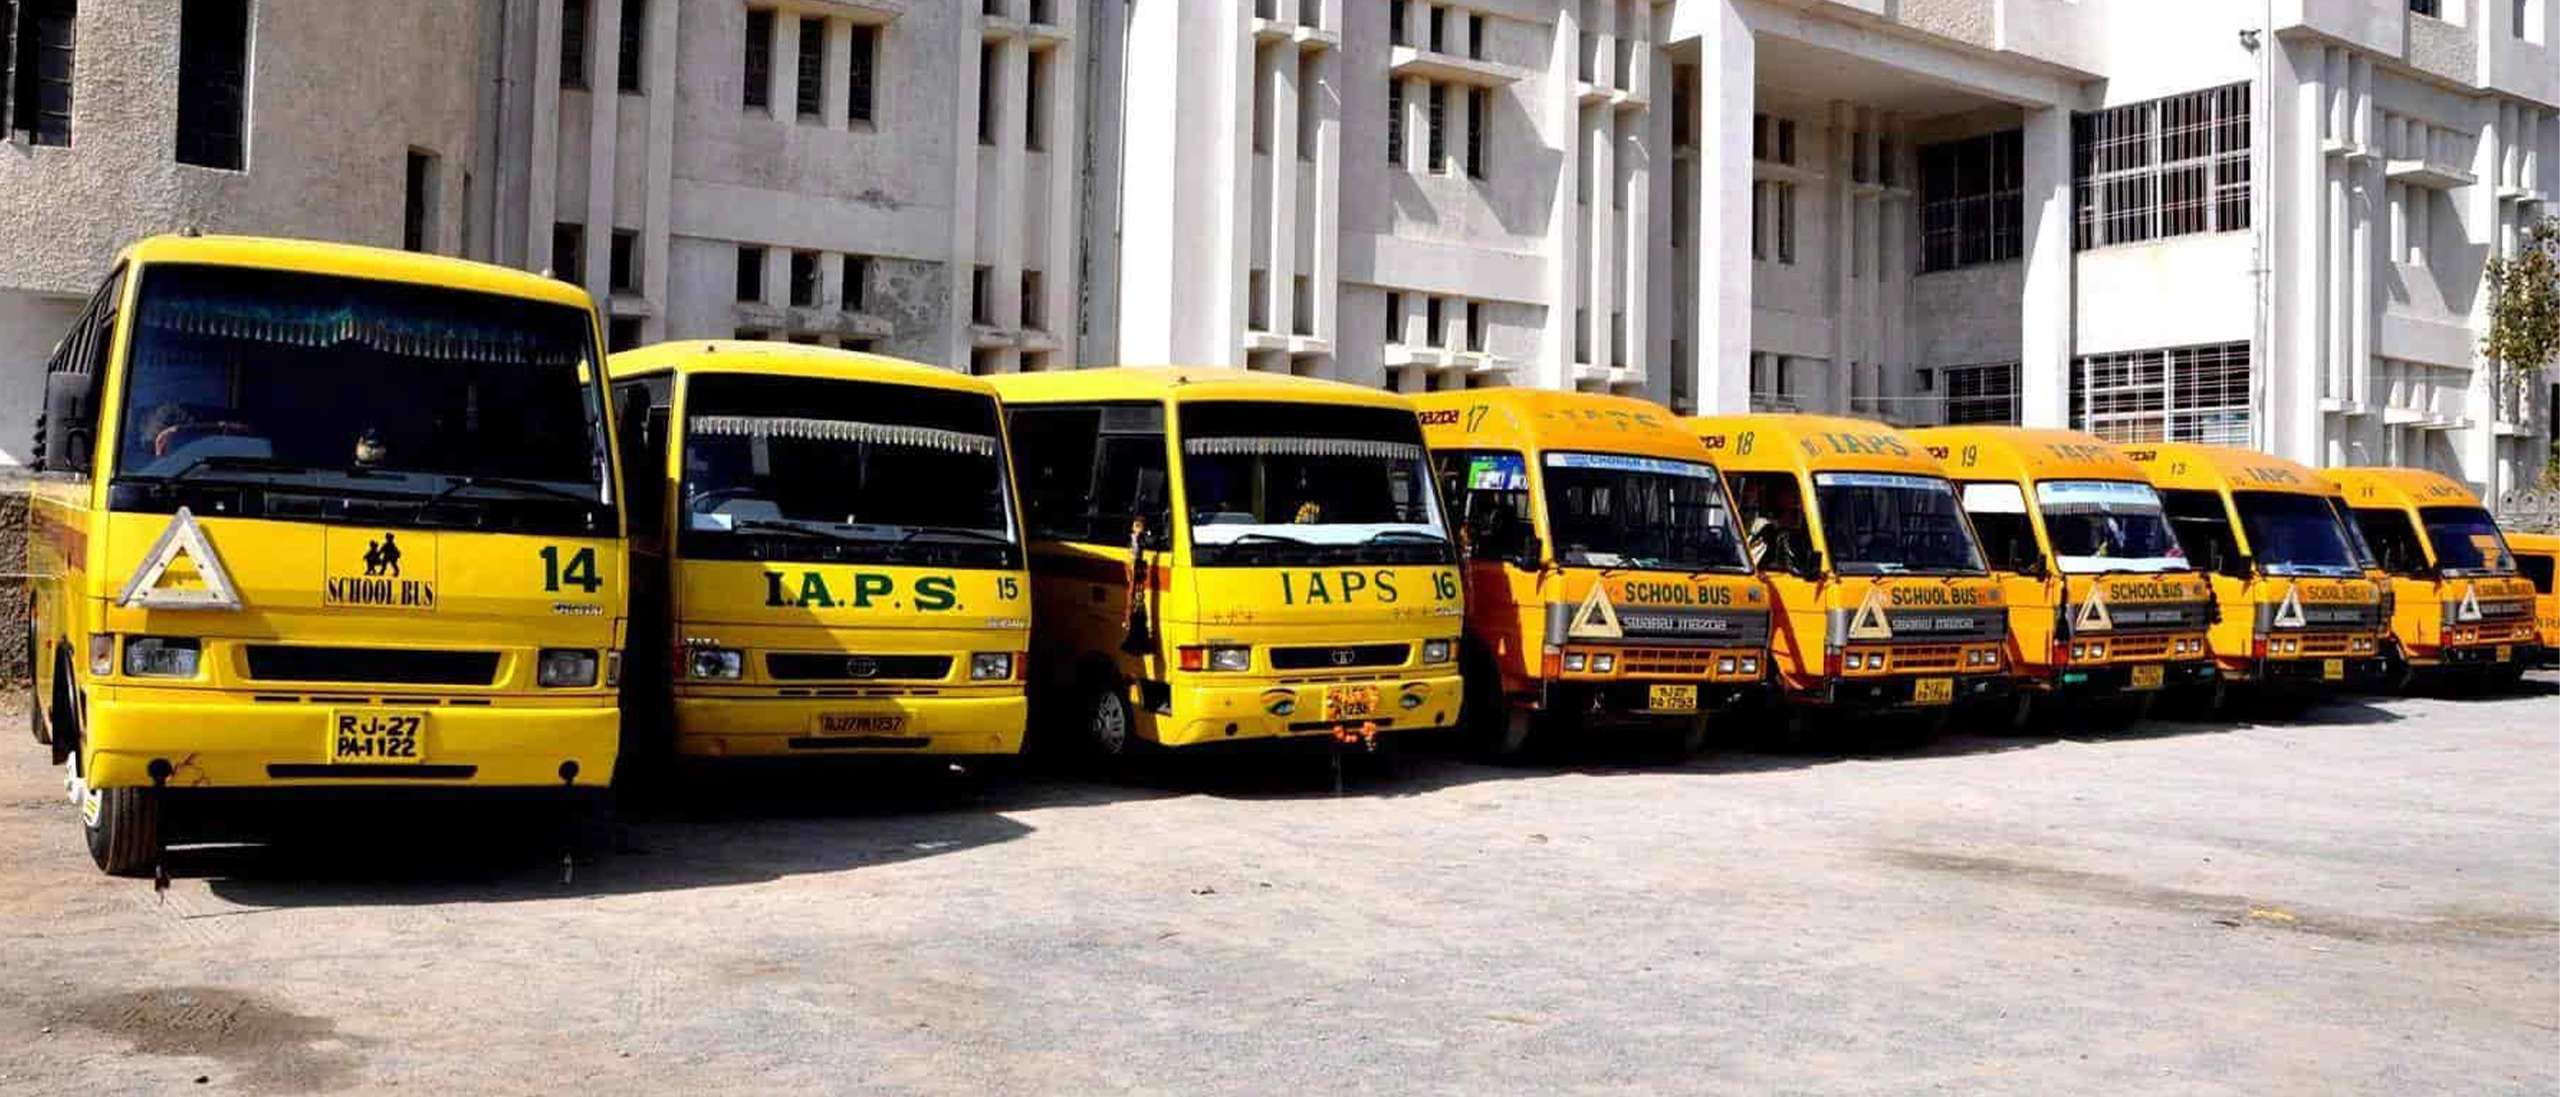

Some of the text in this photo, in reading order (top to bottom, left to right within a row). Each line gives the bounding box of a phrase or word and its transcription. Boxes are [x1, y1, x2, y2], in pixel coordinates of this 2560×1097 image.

[1467, 404, 1489, 432] 17
[1736, 431, 1754, 455] 18
[1961, 445, 1977, 467] 19
[540, 546, 603, 593] 14
[328, 577, 434, 606] SCHOOL BUS
[764, 571, 964, 612] I.A.P.S.
[997, 577, 1018, 600] 15
[1280, 569, 1398, 604] IAPS
[1432, 571, 1456, 600] 16
[1625, 581, 1731, 604] SCHOOL BUS
[1892, 587, 1978, 605] SCHOOL BUS
[2111, 582, 2183, 600] SCHOOL BUS
[340, 716, 421, 736] RJ-27
[337, 737, 417, 757] PA-1122
